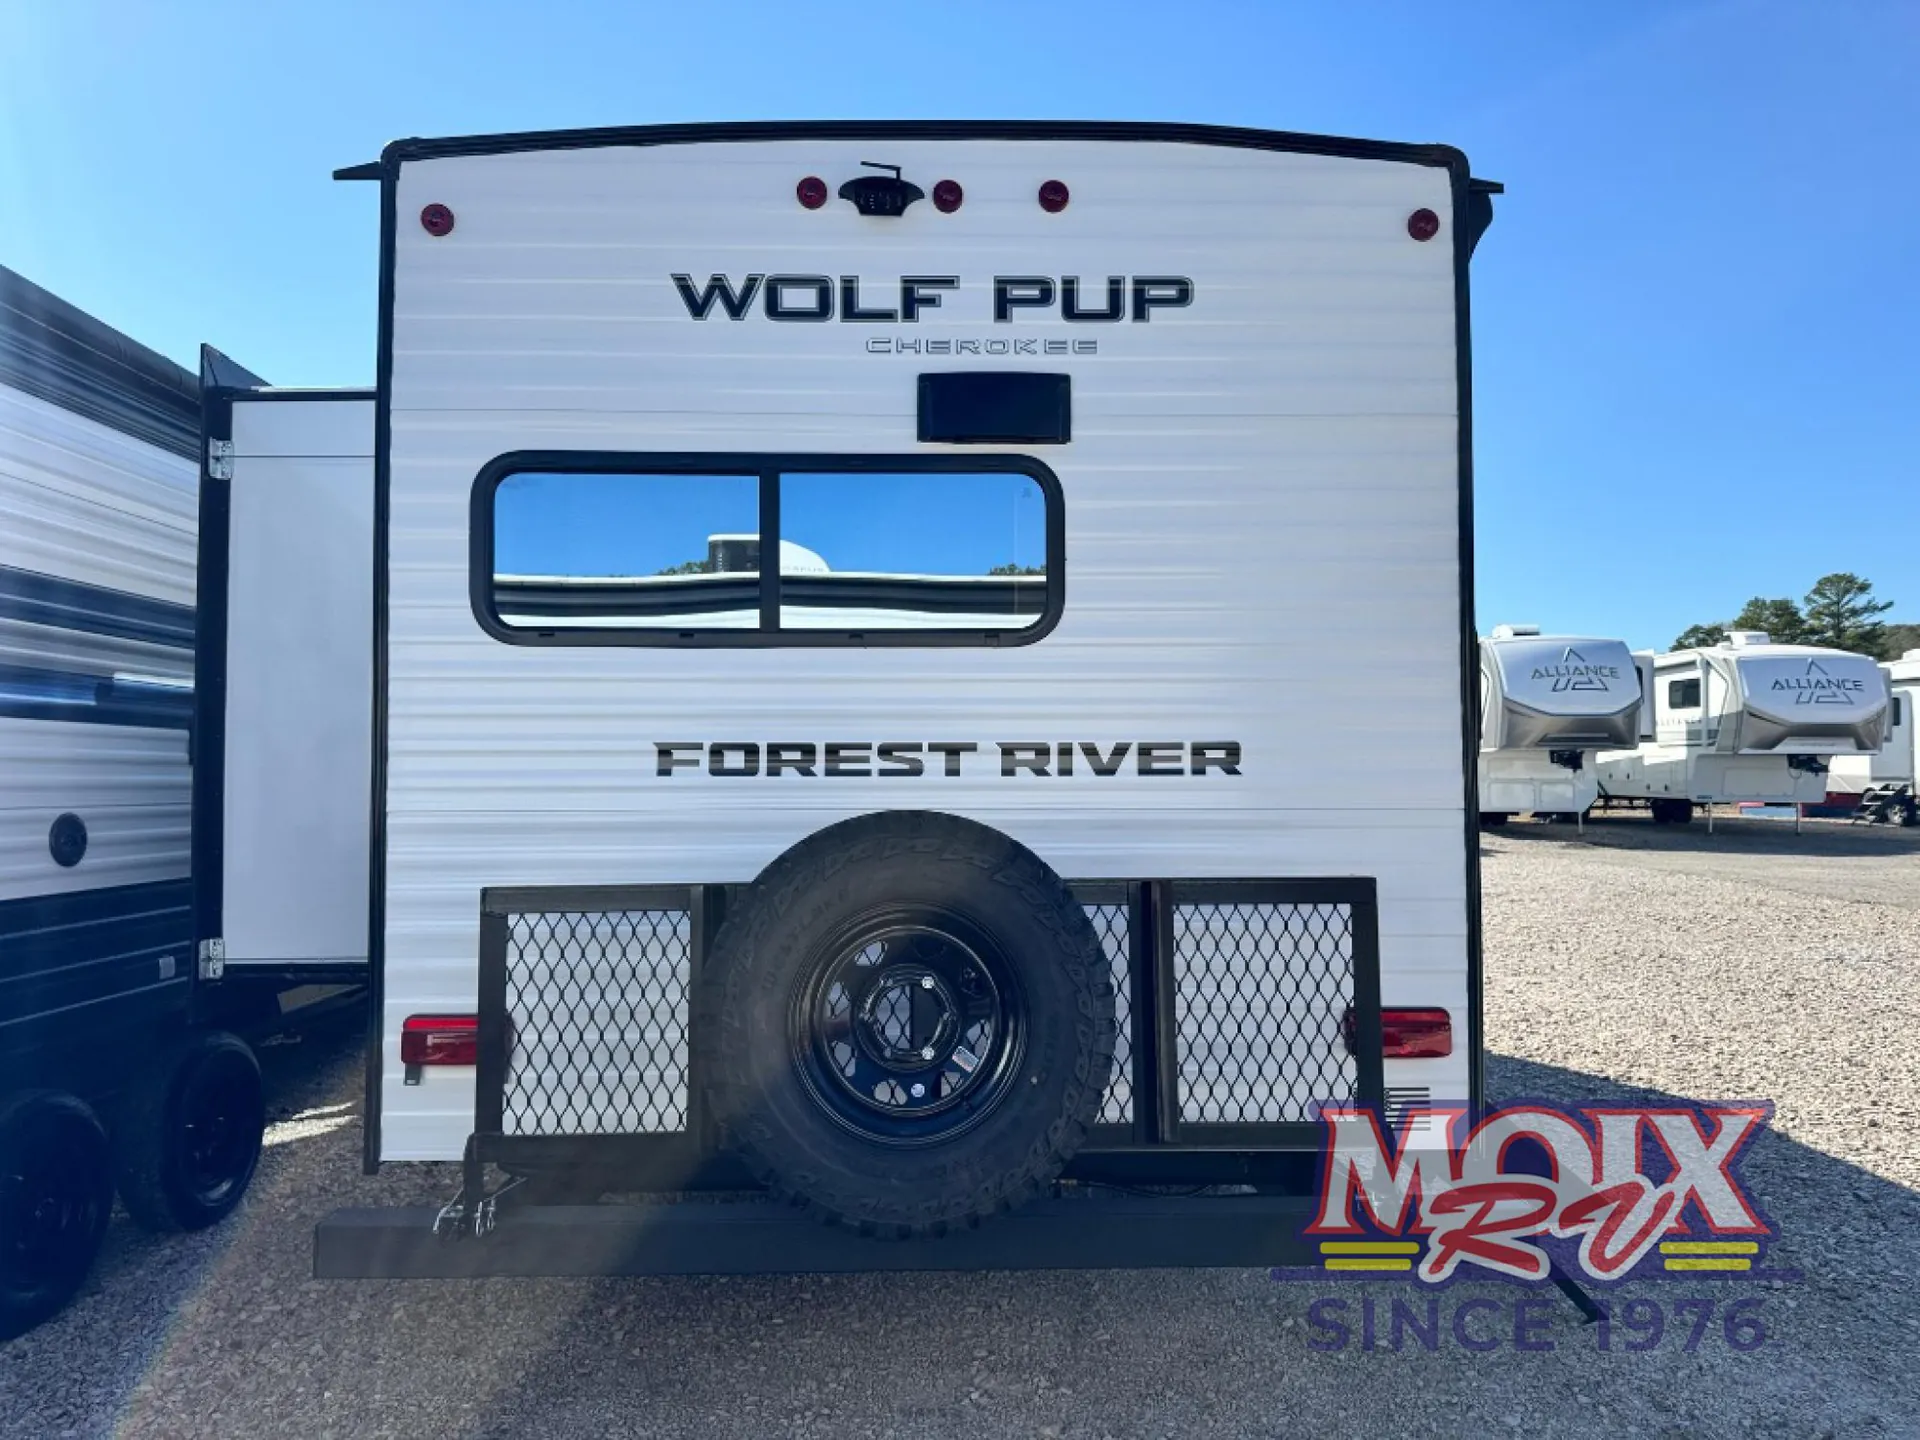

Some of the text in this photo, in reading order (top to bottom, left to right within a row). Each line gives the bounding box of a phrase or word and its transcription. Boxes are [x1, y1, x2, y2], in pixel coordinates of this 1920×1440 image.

[670, 273, 1194, 324] WOLF PUP
[866, 337, 1098, 355] CHEROKEE
[1531, 665, 1620, 679] ALLIANCE
[1771, 678, 1865, 692] ALLIANCE
[653, 740, 1243, 777] FOREST RIVER
